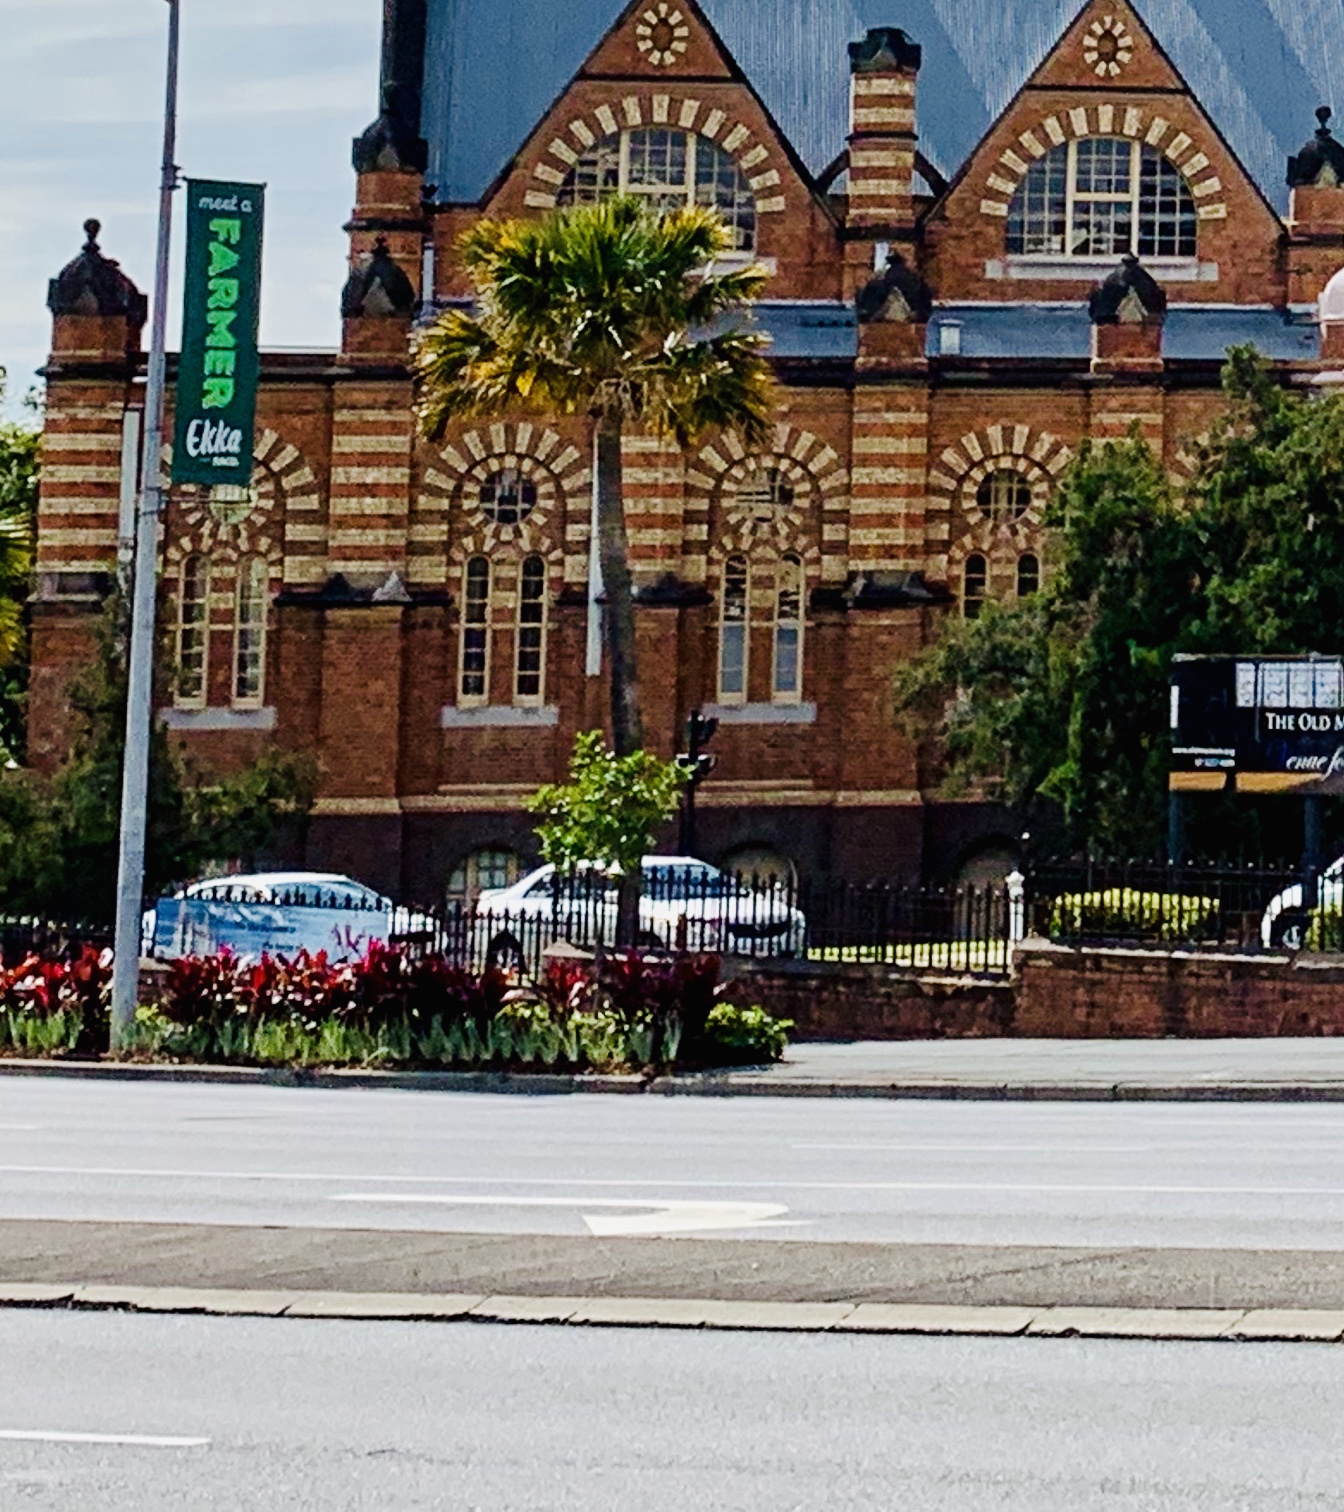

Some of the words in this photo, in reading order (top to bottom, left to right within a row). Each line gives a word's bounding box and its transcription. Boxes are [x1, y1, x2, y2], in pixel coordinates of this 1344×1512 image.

[199, 194, 238, 211] meet
[240, 199, 253, 213] a
[202, 217, 241, 409] FARMER
[186, 418, 242, 457] Ekka
[1265, 712, 1295, 731] THE
[1297, 712, 1331, 731] OLD
